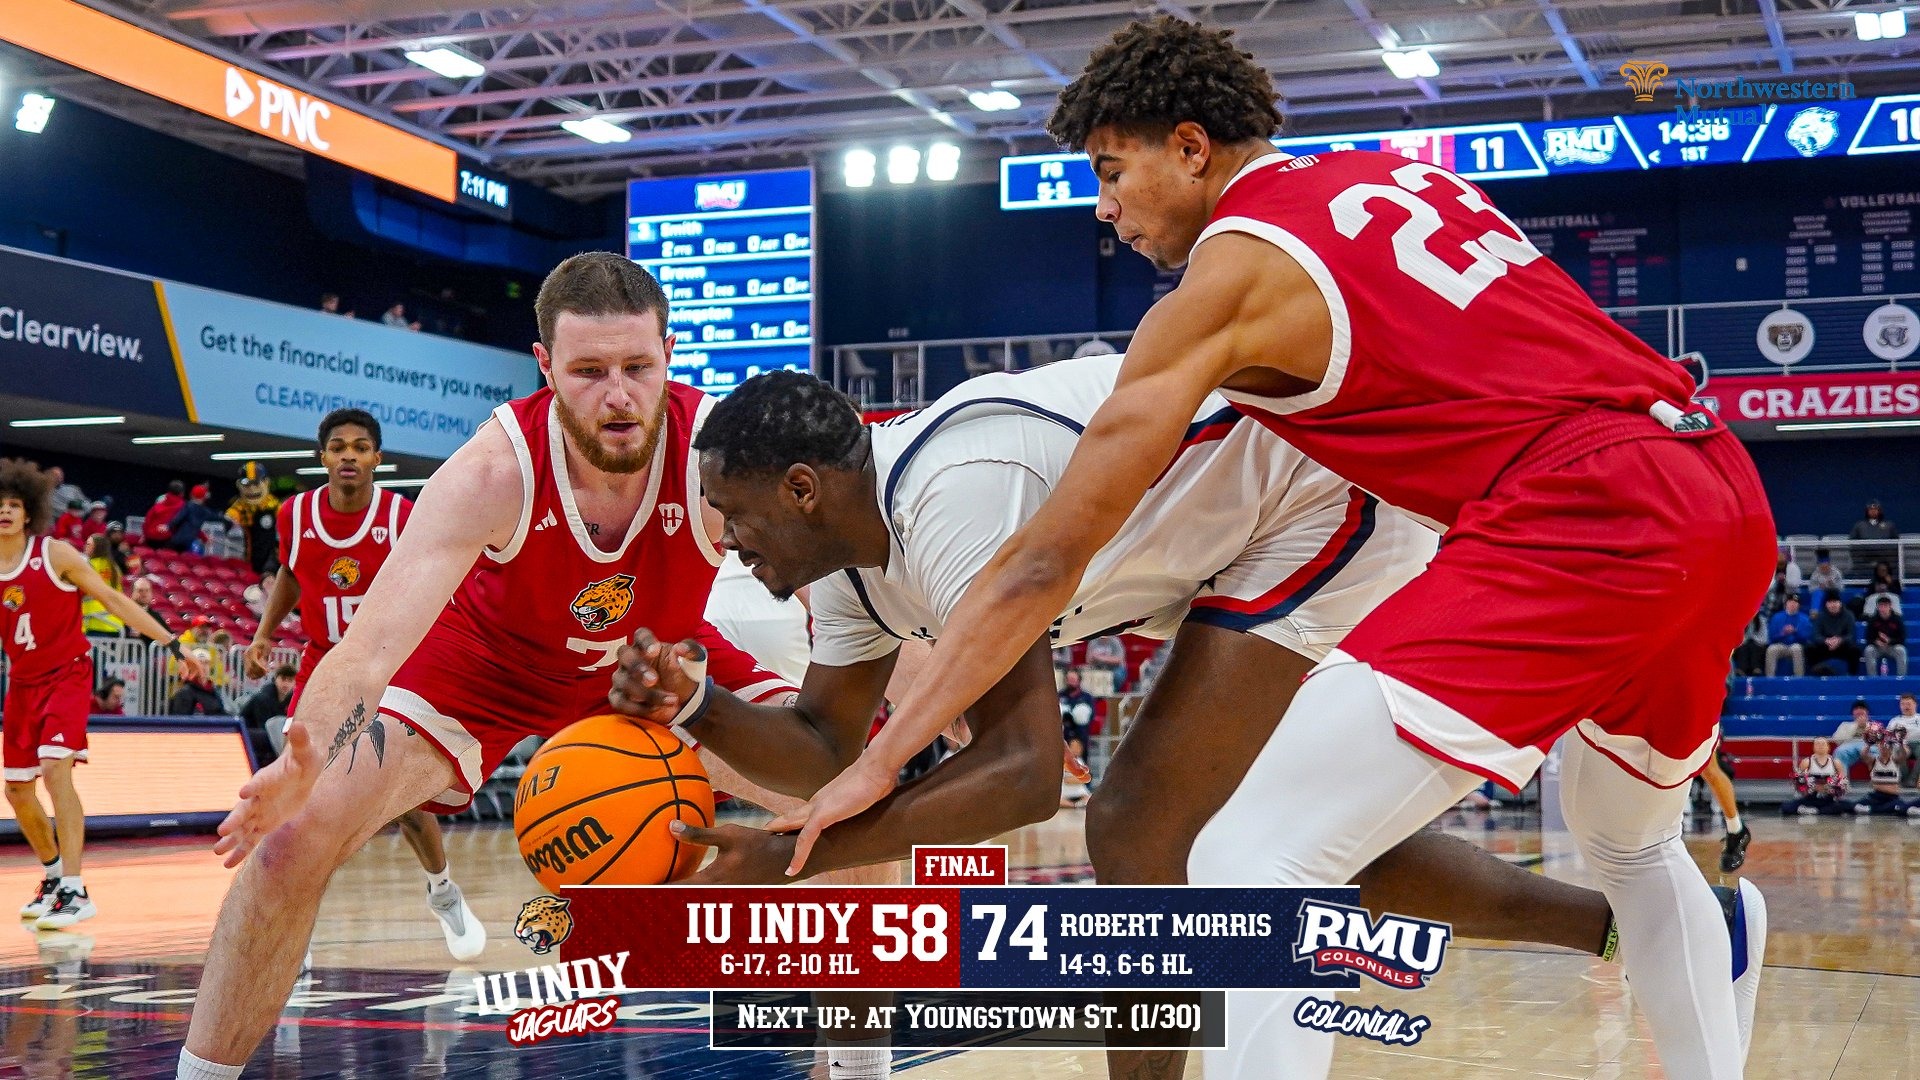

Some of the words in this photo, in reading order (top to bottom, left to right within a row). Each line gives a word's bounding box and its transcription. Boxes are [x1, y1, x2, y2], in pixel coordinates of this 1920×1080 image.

[257, 79, 331, 151] PNC
[1470, 137, 1504, 170] 11
[1547, 127, 1615, 157] RMU
[1680, 146, 1708, 161] 1ST
[460, 170, 485, 199] 7:11
[487, 180, 510, 208] PM
[1328, 162, 1544, 310] 23
[201, 325, 236, 353] Get
[242, 334, 273, 361] the
[278, 339, 360, 377] financial
[363, 362, 437, 390] answers
[439, 379, 471, 398] you
[473, 382, 515, 402] need
[1738, 384, 1918, 419] CRAZIES
[14, 612, 37, 651] 4
[566, 635, 628, 672] 7
